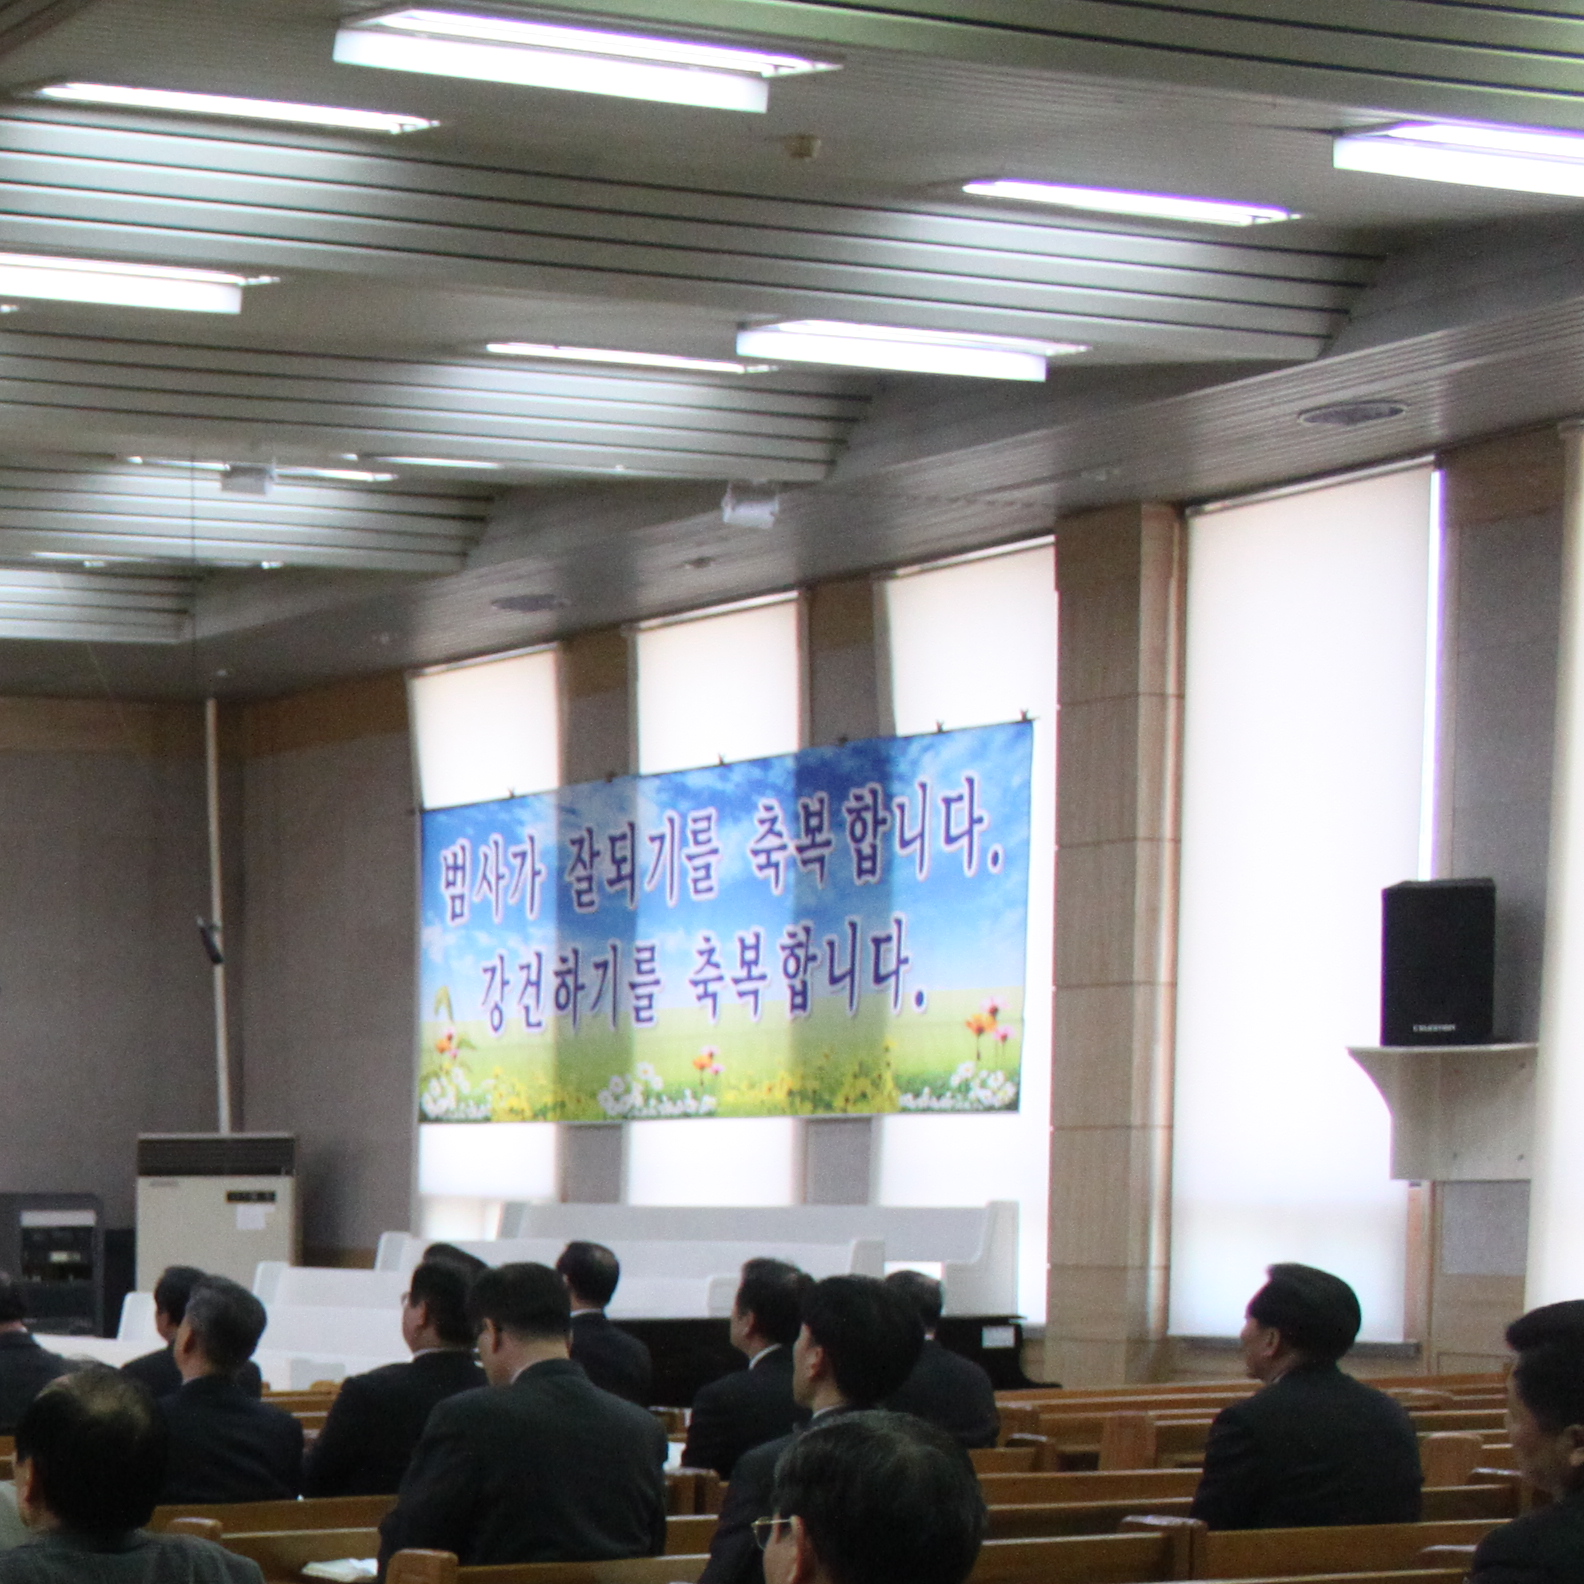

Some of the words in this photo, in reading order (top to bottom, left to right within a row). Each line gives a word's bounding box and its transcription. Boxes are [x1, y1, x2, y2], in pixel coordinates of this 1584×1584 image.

[441, 834, 545, 925] 범사가
[565, 807, 722, 912] 잘되기를
[749, 774, 1005, 896] 축복합니다.
[480, 939, 663, 1037] 강건하기를
[689, 910, 928, 1025] 축복합니다.
